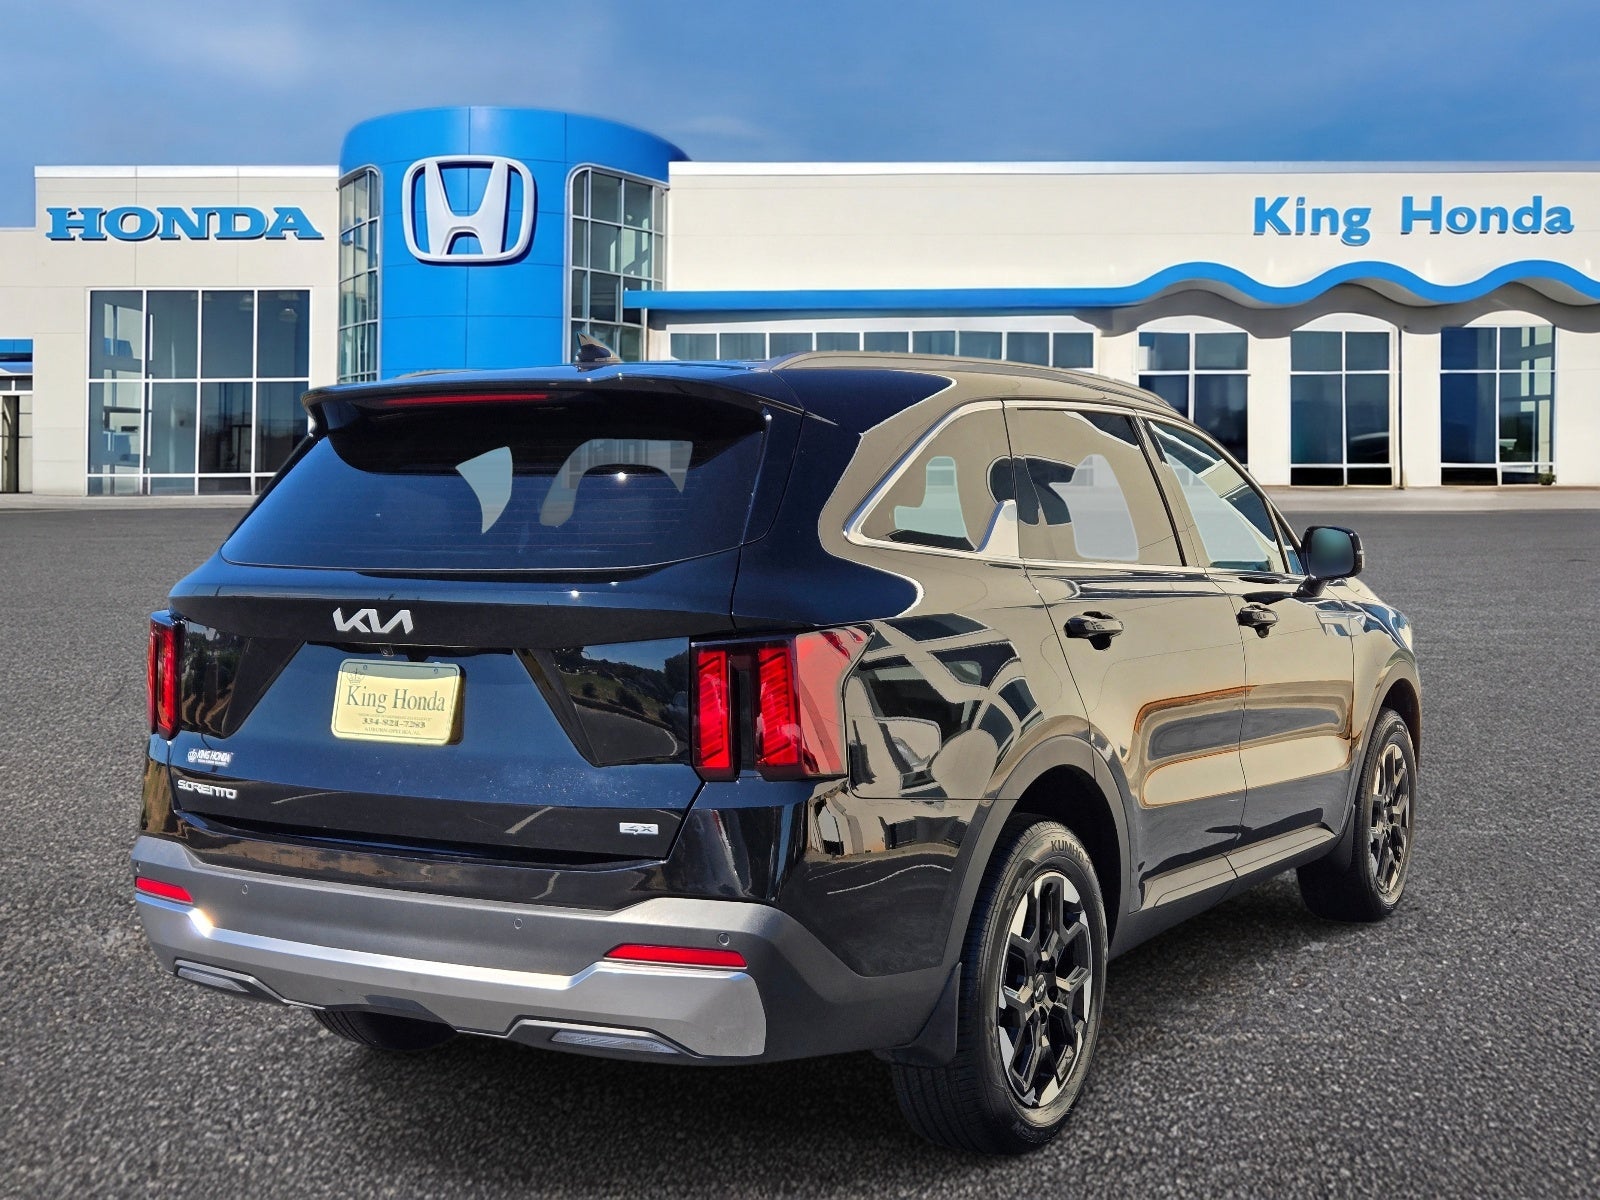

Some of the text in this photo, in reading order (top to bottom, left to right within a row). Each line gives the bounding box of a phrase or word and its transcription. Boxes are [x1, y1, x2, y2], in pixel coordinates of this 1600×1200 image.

[45, 206, 325, 241] HONDA
[1253, 195, 1575, 246] King Honda
[332, 607, 414, 635] KIA
[346, 685, 446, 713] King Honda
[177, 779, 238, 800] SORENTO
[1050, 840, 1085, 862] KUMHO
